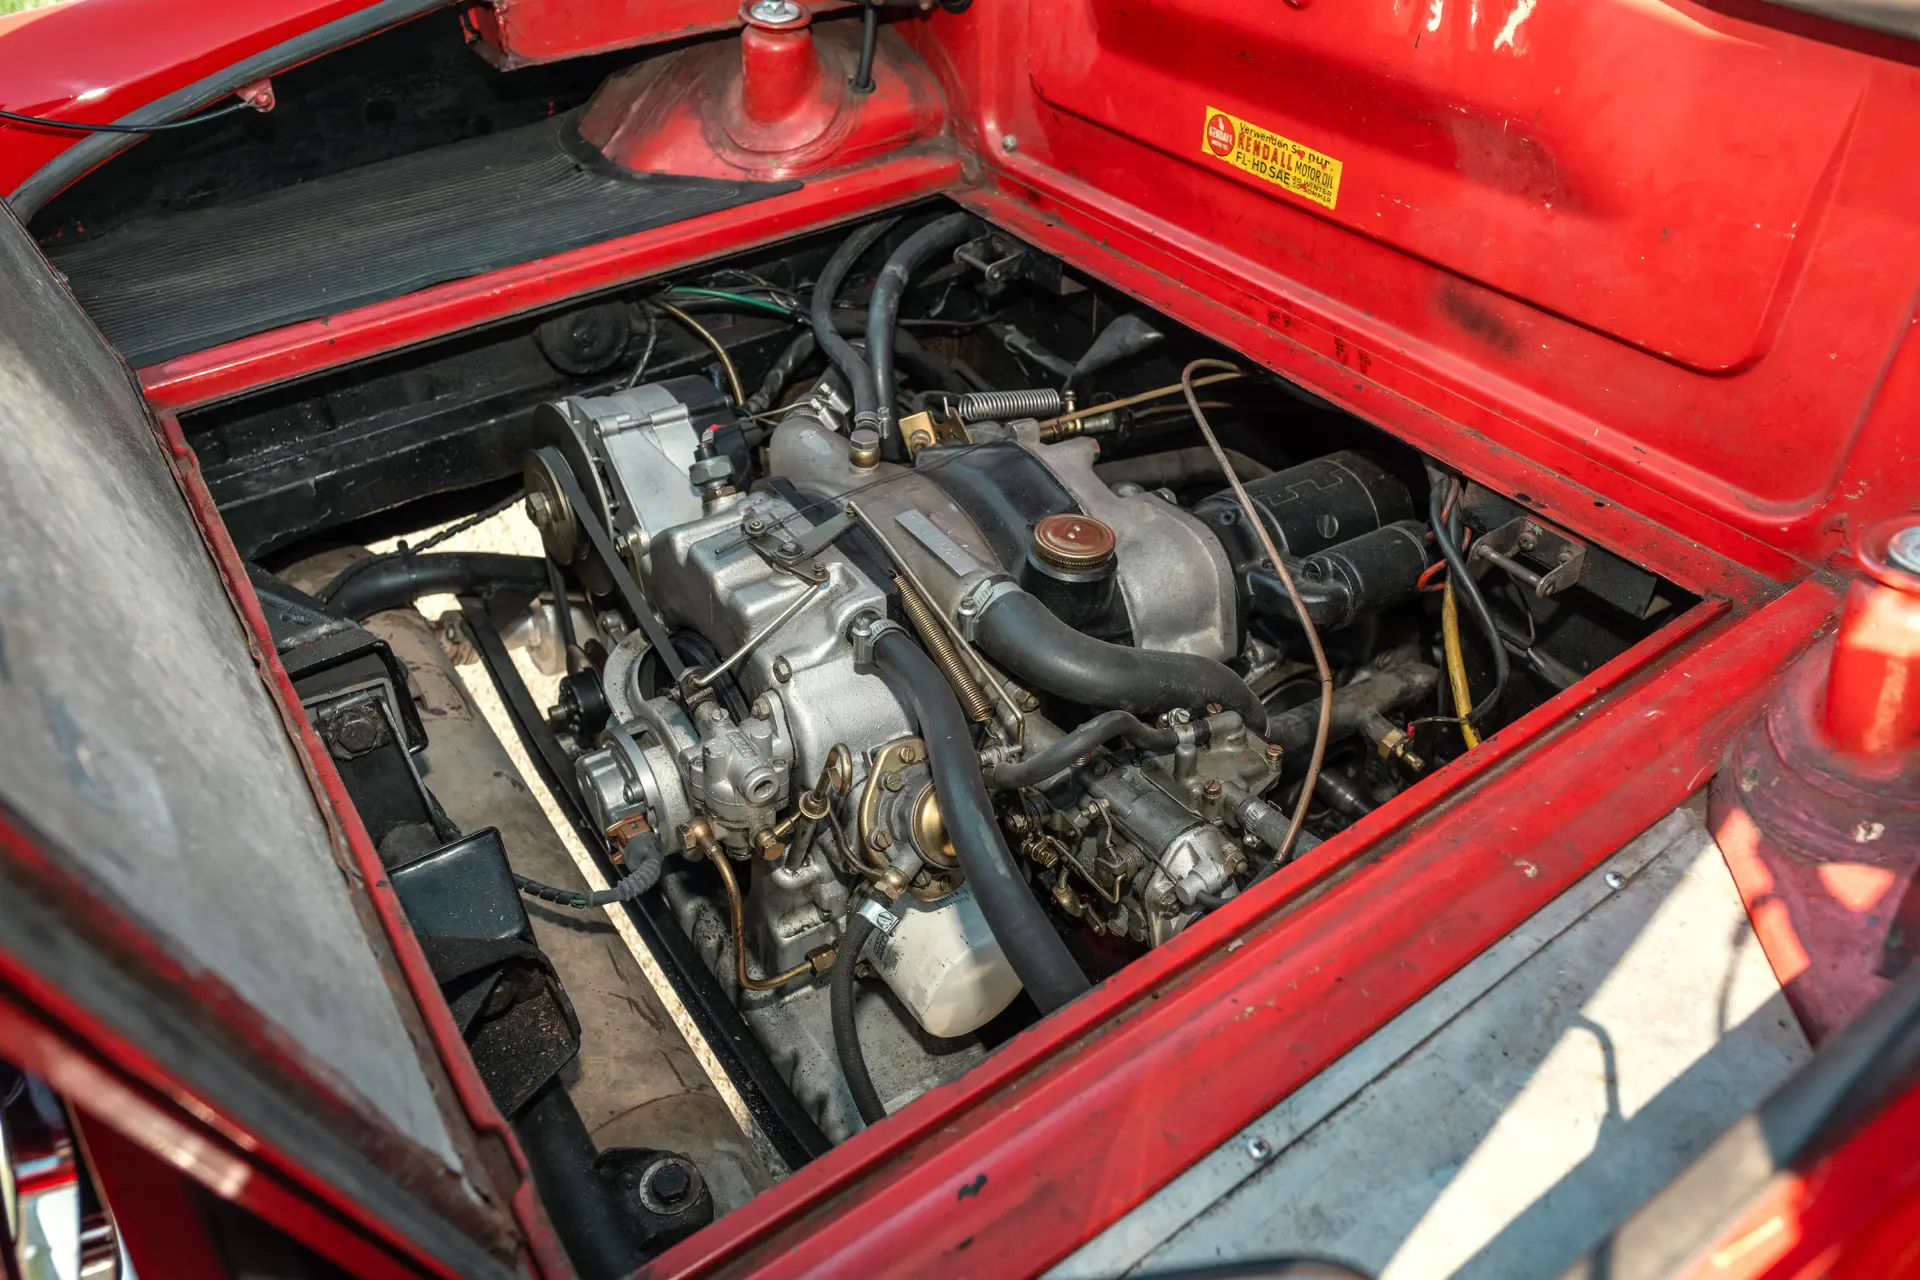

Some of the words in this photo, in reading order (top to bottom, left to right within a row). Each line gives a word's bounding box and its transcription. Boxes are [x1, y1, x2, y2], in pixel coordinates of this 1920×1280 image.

[1237, 131, 1292, 171] KENDALL
[1294, 160, 1321, 184] MOTOR
[1321, 172, 1334, 189] OIL
[1240, 122, 1289, 151] Verwenden
[1308, 153, 1331, 167] nur
[1268, 166, 1291, 185] SAE
[1303, 180, 1333, 198] WINTER
